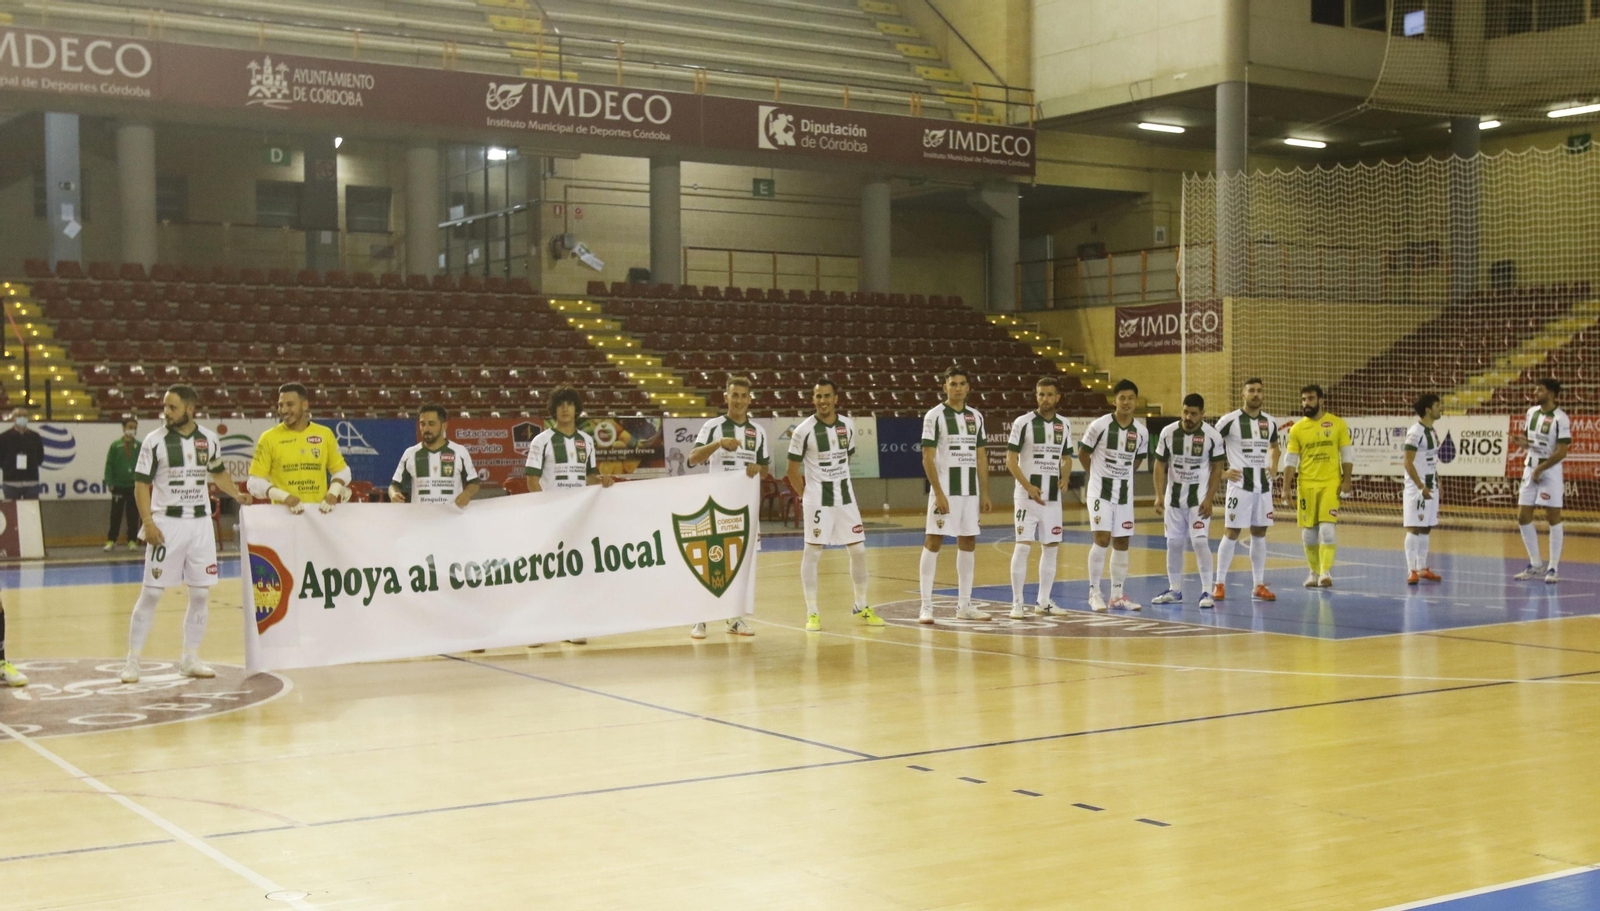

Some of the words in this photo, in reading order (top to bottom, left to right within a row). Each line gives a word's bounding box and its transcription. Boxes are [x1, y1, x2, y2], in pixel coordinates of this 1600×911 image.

[293, 68, 375, 90] AYUNTAMIENTO
[22, 77, 38, 88] de
[41, 78, 97, 92] Deportes
[100, 82, 151, 98] Córdoba
[293, 87, 310, 102] DE
[309, 87, 363, 107] CÓRDOBA
[531, 83, 672, 125] IMDECO
[487, 117, 526, 129] Instituto
[528, 120, 574, 134] Municipal
[575, 124, 588, 135] de
[590, 126, 632, 138] Deportes
[633, 128, 671, 141] Córdoba
[801, 119, 867, 138] Diputación
[801, 135, 817, 148] de
[820, 137, 868, 153] Córdoba
[949, 129, 1031, 157] IMDECO
[270, 149, 283, 163] D
[923, 151, 946, 159] Instituto
[947, 153, 974, 163] Municipal
[759, 182, 768, 195] E
[1141, 310, 1219, 337] IMDECO
[455, 429, 508, 439] Estaciones
[1460, 430, 1503, 438] COMERCIAL
[635, 447, 655, 455] fresca
[1459, 438, 1503, 455] RIOS
[56, 483, 66, 498] y
[1356, 490, 1395, 500] Deportes
[1094, 500, 1100, 511] 8
[1228, 497, 1238, 510] 29
[1416, 500, 1426, 510] 14
[717, 517, 743, 525] CÓRDOBA
[814, 510, 821, 523] 5
[1016, 509, 1026, 522] 41
[151, 545, 166, 562] 10
[299, 560, 401, 609] Apoya
[409, 554, 439, 592] al
[450, 540, 584, 589] comercio
[592, 529, 666, 573] local
